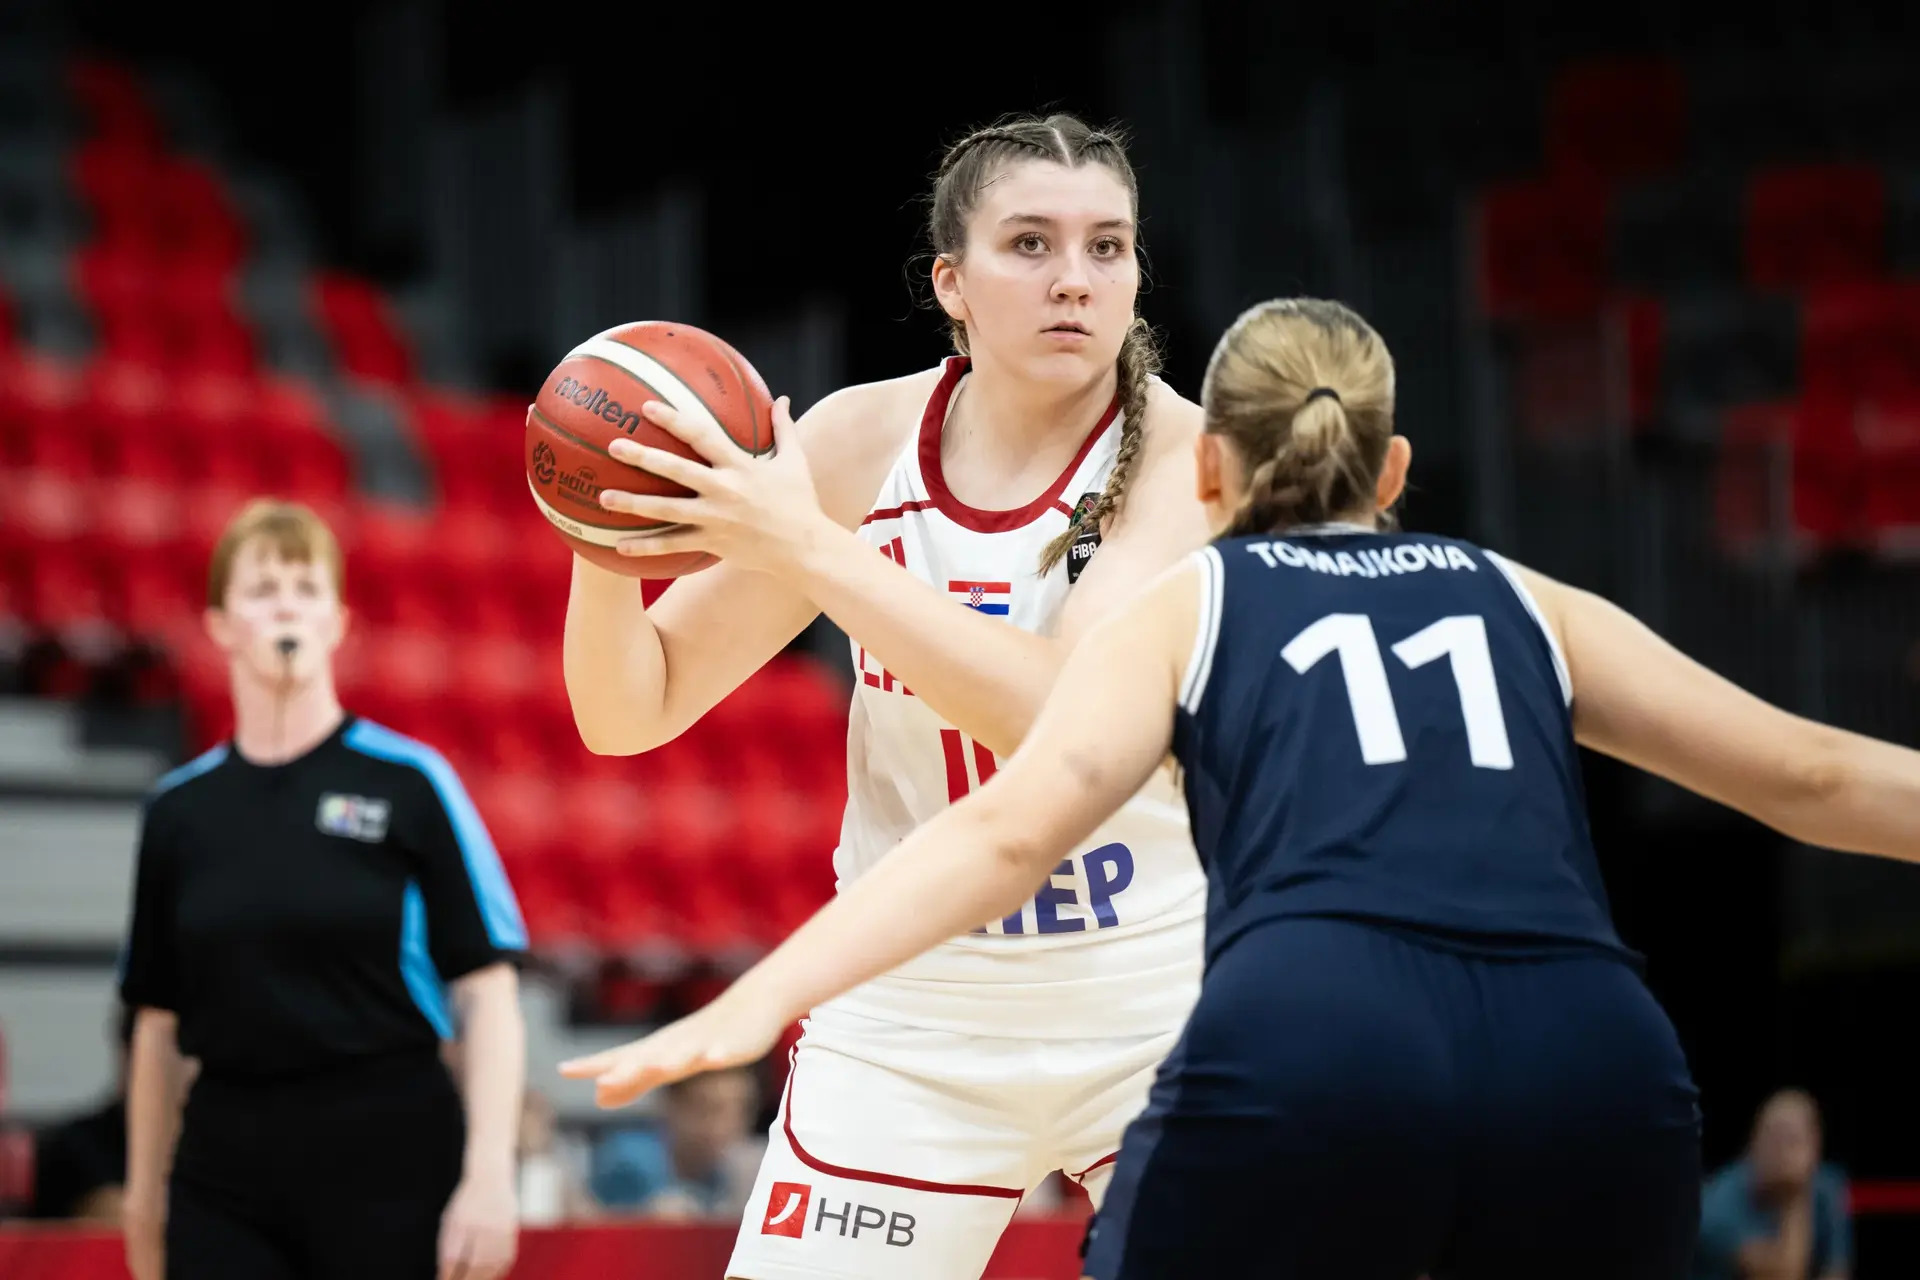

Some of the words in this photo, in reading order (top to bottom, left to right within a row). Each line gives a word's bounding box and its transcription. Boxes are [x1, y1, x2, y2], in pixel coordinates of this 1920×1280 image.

[554, 376, 640, 435] molten
[558, 471, 605, 498] YOUT
[1072, 541, 1098, 560] FIBA
[1246, 541, 1478, 578] TOMAJKOVA
[1280, 613, 1514, 770] 11
[969, 842, 1135, 935] EP
[815, 1197, 916, 1247] HPB
